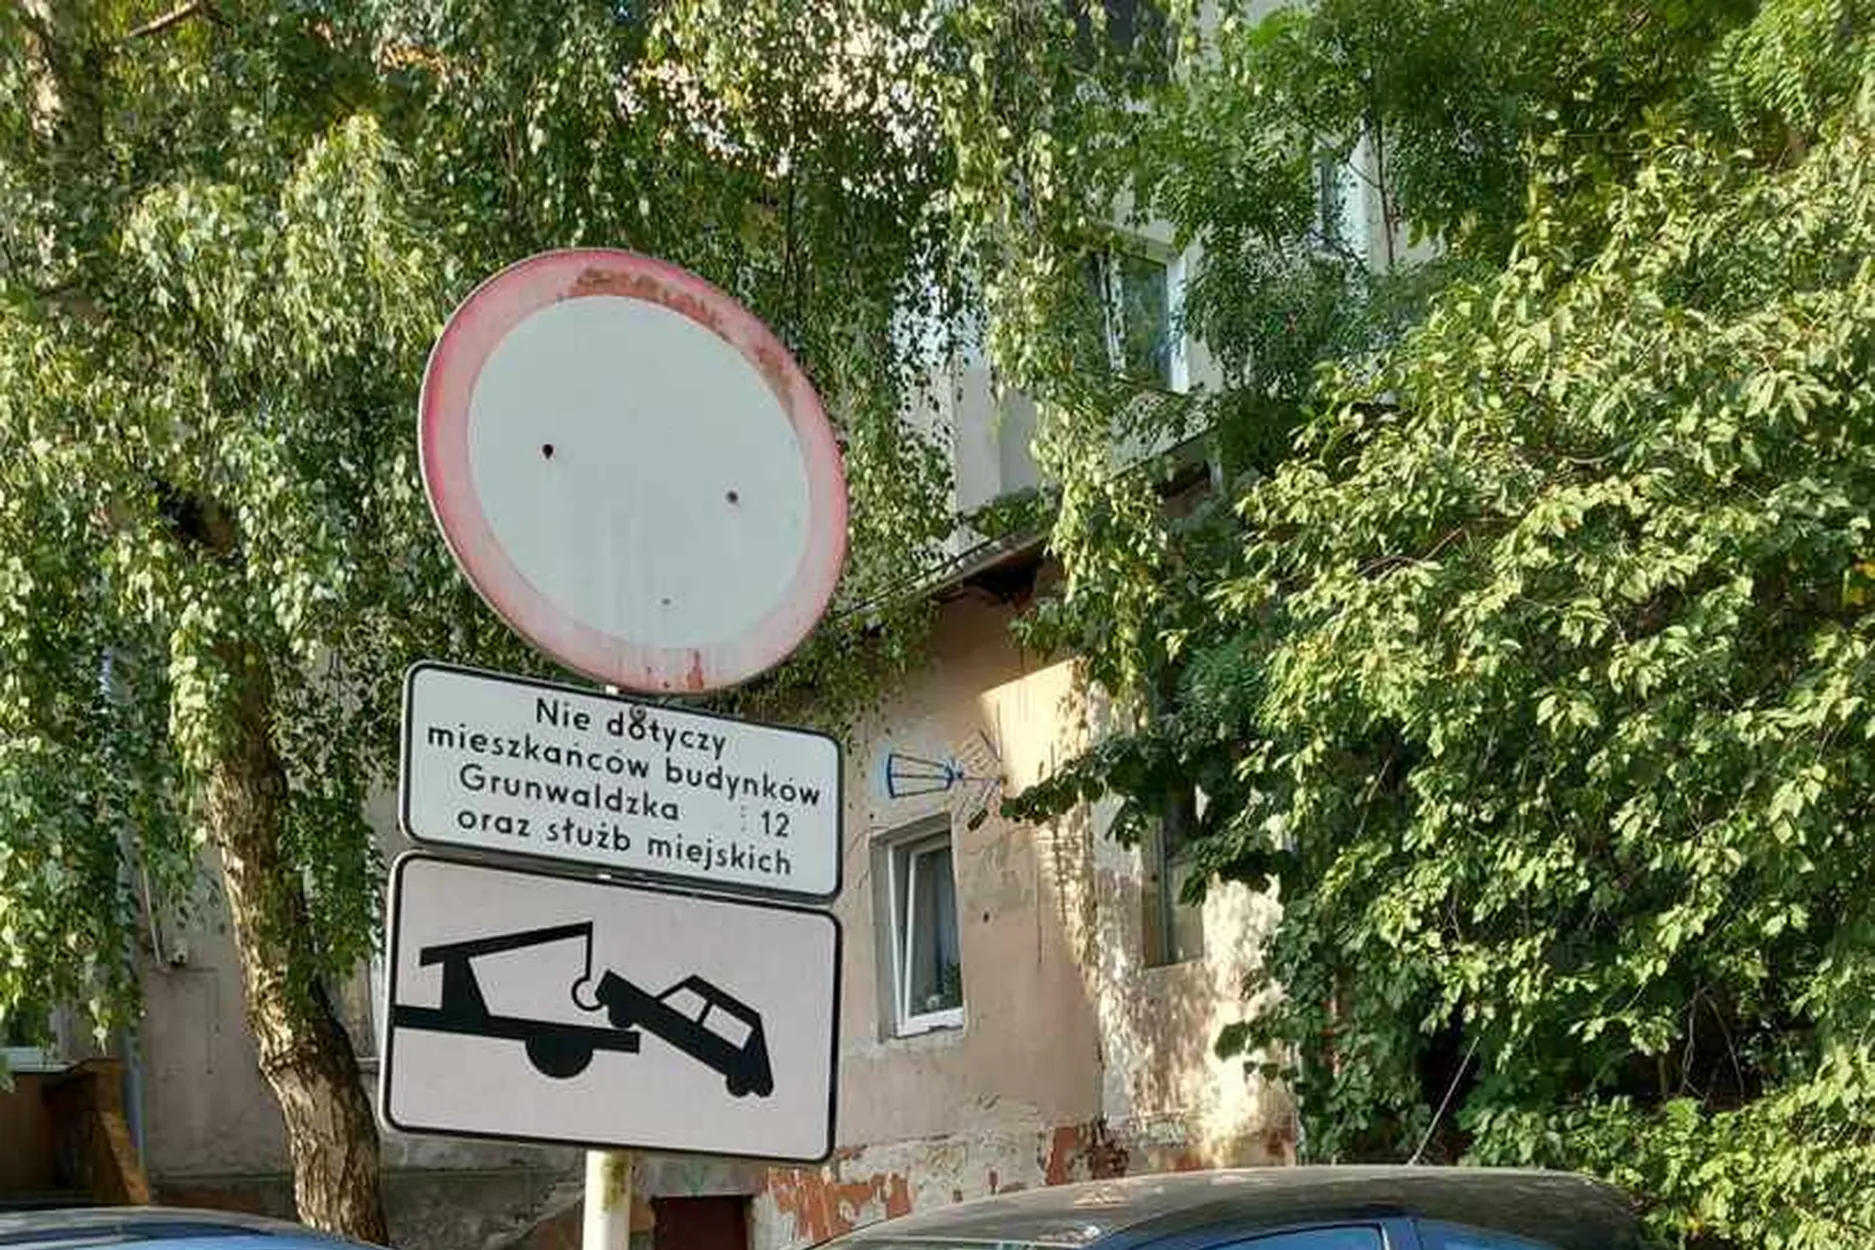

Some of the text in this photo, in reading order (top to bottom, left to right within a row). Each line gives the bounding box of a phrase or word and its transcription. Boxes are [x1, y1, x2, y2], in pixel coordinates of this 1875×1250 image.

[536, 698, 726, 760] Nie dotyczy
[428, 723, 820, 805] mieszkańców budynków
[460, 763, 789, 837] Grunwaldzka 12
[457, 810, 791, 875] oraz służb miejskich
